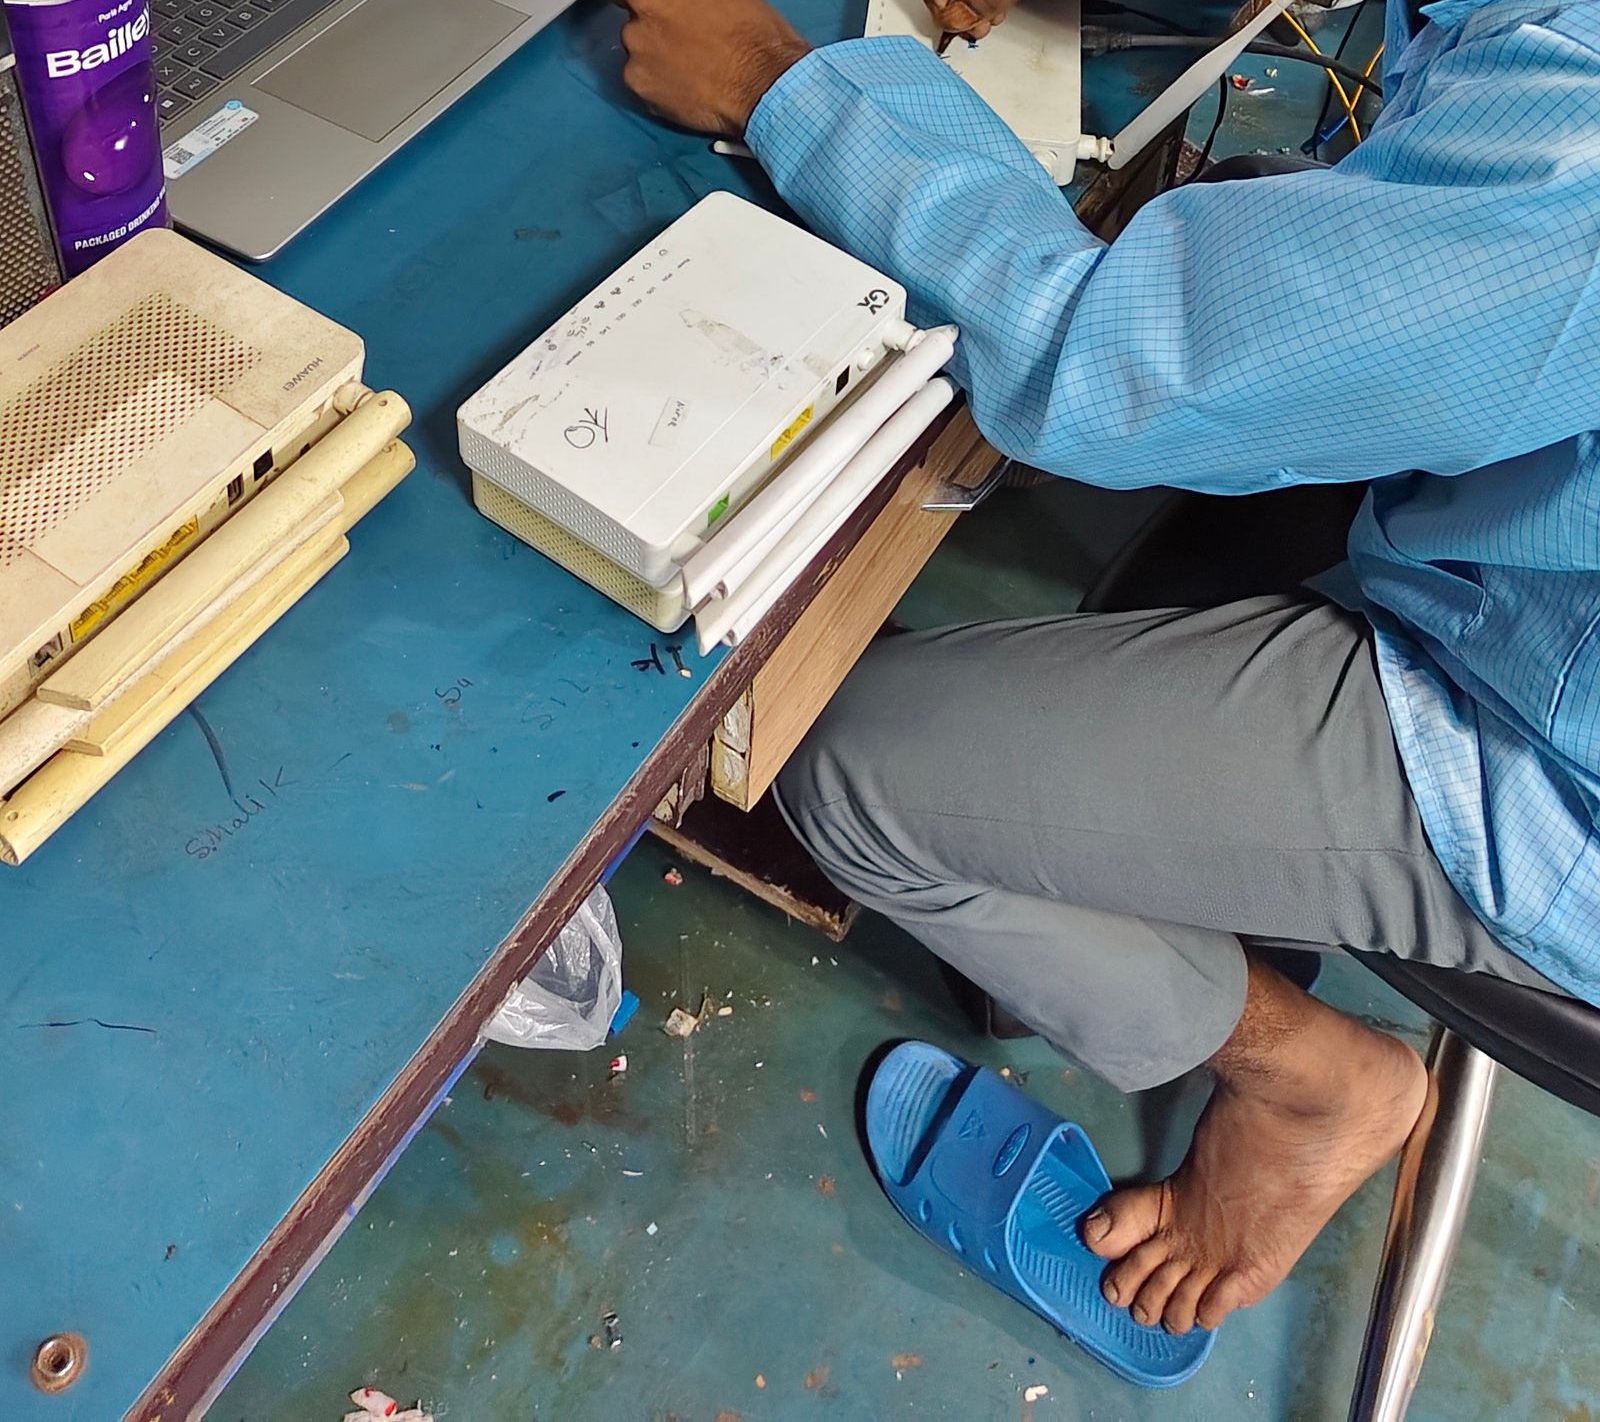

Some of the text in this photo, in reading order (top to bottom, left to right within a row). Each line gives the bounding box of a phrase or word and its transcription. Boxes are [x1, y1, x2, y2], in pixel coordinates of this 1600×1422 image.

[98, 9, 117, 23] Parle
[75, 226, 127, 250] PACKAGED
[282, 357, 324, 392] HUAWEI
